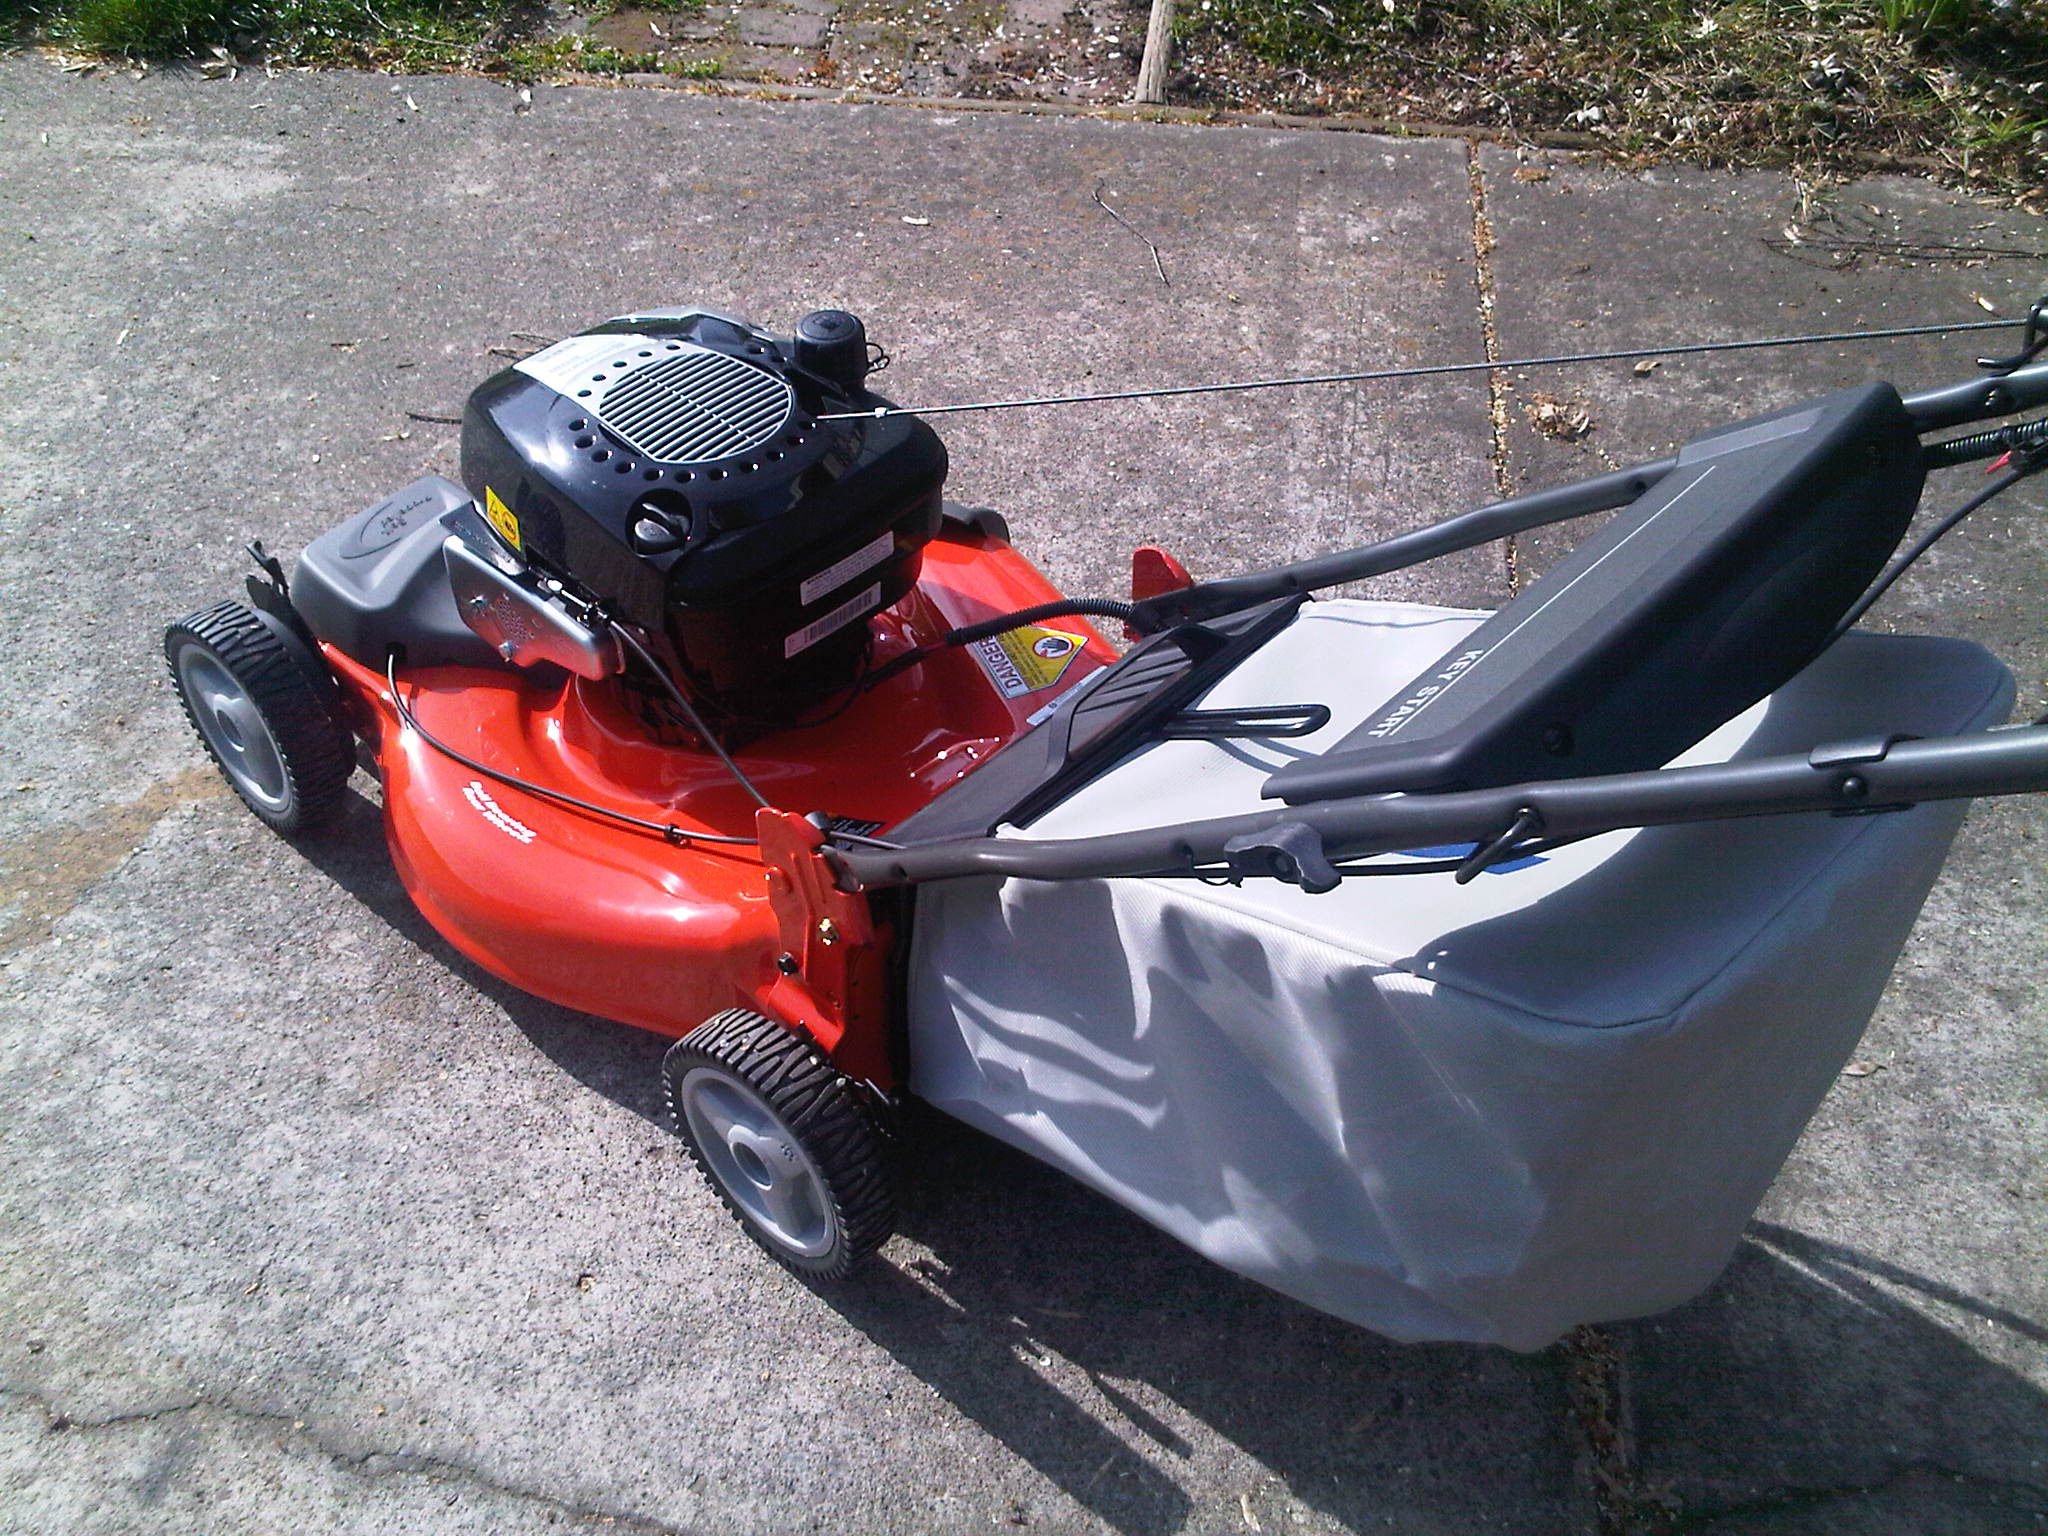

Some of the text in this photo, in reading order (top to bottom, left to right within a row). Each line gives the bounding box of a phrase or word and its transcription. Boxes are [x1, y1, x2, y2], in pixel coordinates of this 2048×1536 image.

[980, 637, 1023, 689] DANGER
[1368, 649, 1484, 738] KEY START
